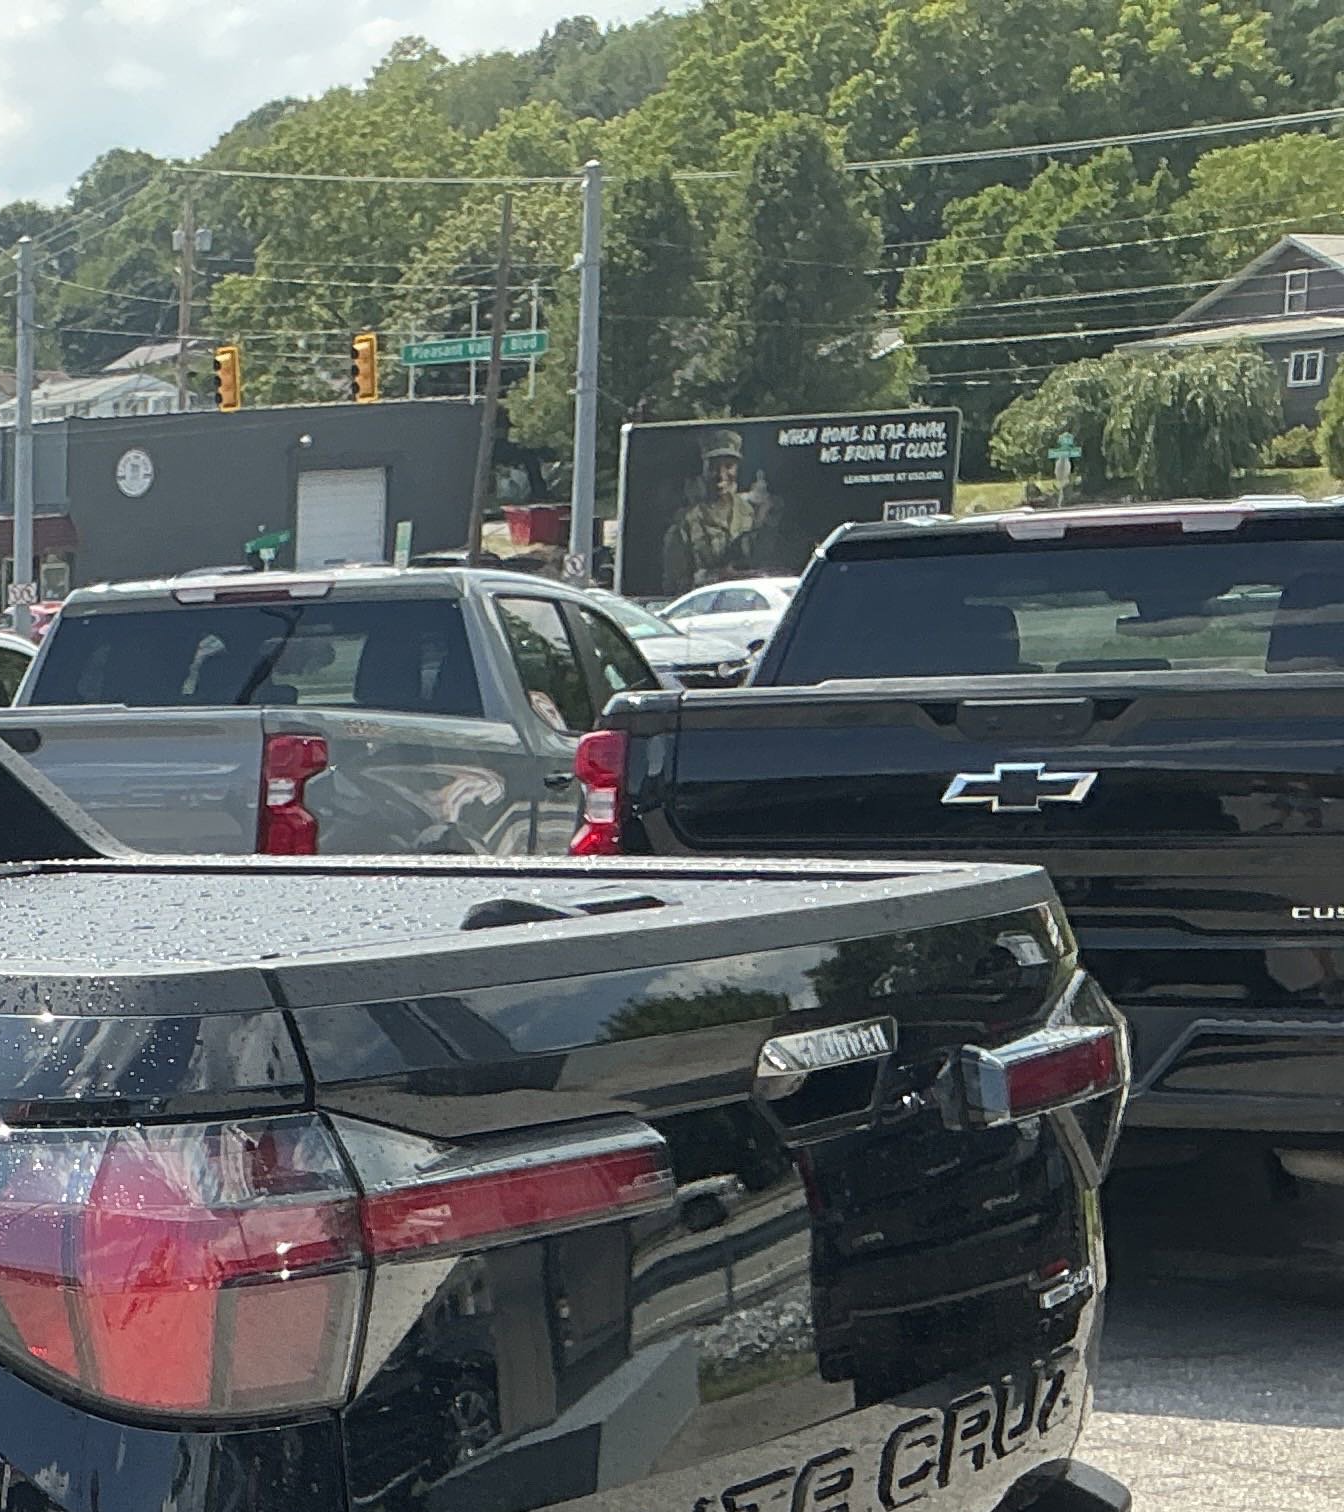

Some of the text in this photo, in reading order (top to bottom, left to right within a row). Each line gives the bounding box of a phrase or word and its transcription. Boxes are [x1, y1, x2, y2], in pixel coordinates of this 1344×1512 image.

[411, 343, 463, 359] Pleasant
[510, 335, 537, 351] Blvd
[778, 427, 818, 446] WHEN
[820, 425, 860, 444] HOME
[862, 424, 878, 441] IS
[880, 423, 907, 440] FAR
[820, 441, 947, 463] WE BRING IT CLOSE
[878, 1346, 1074, 1511] CRUZ
